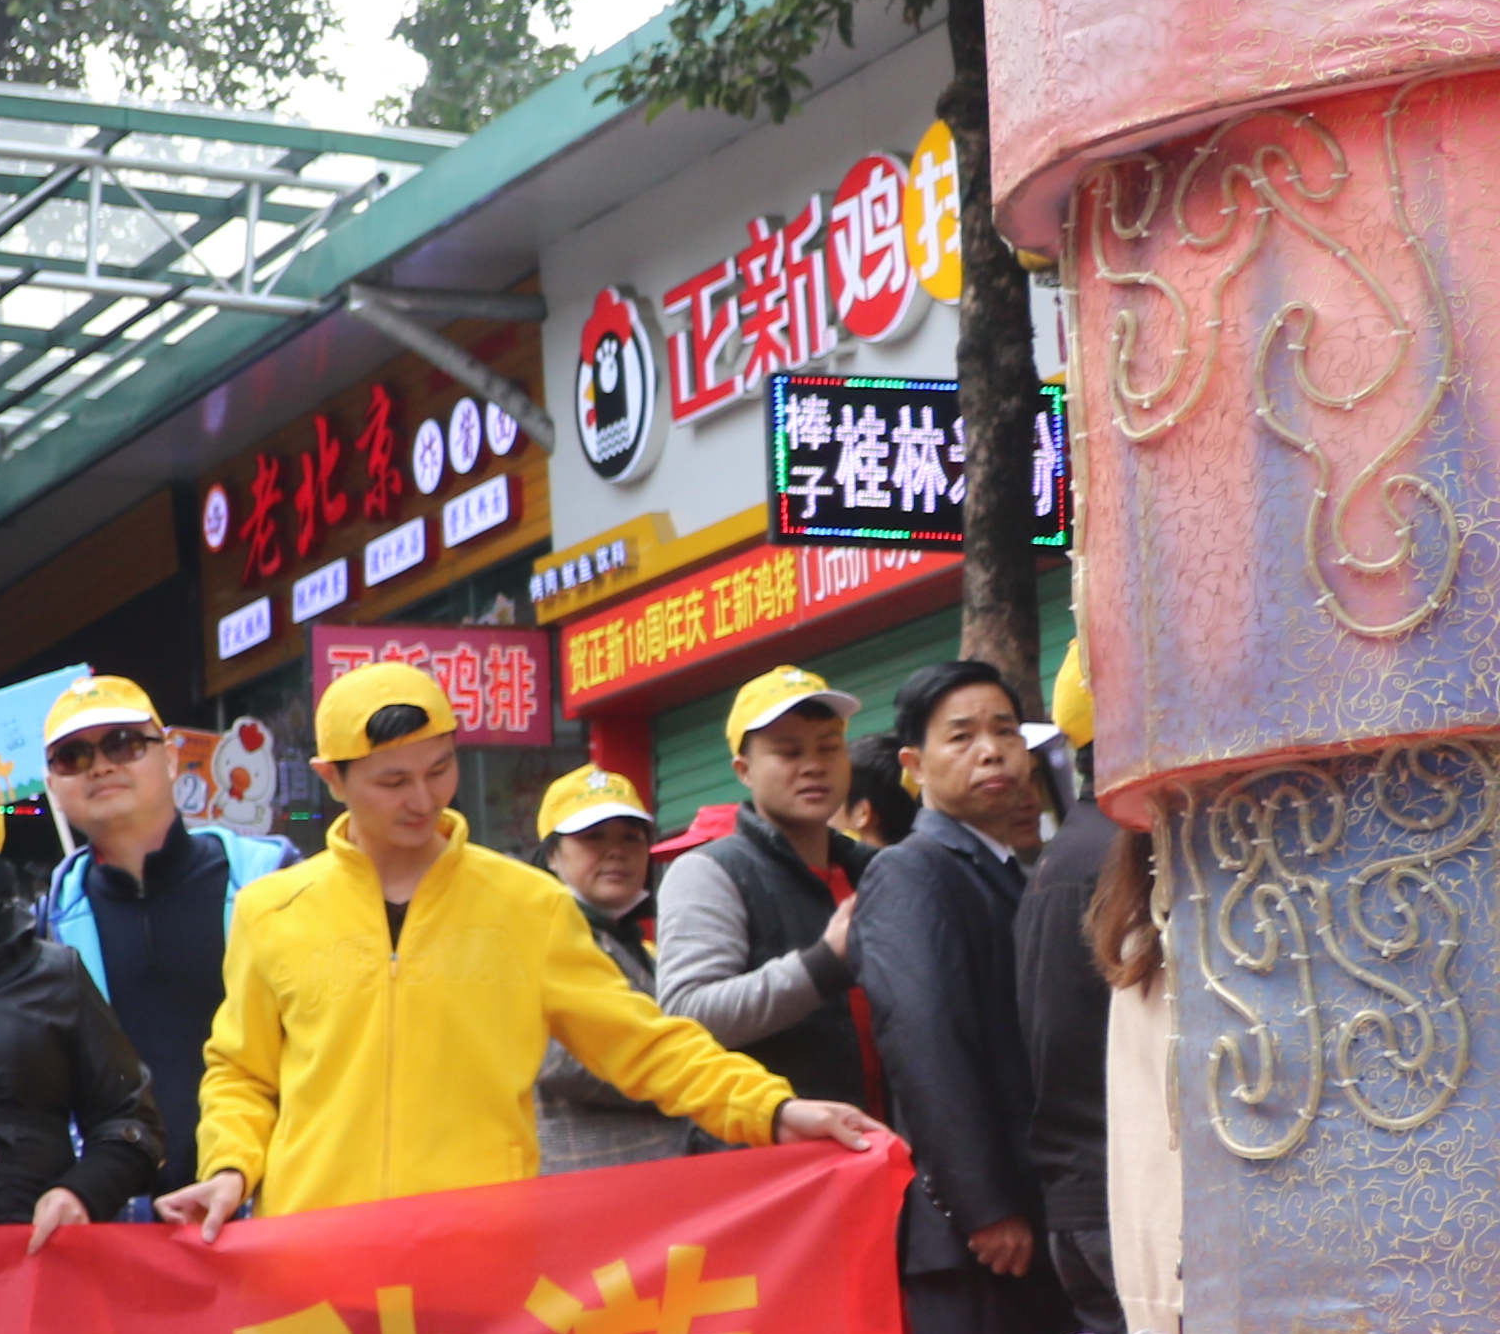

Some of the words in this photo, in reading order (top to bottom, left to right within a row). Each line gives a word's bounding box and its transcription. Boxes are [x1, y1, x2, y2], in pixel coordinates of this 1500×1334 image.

[567, 588, 707, 695] 贺正新18周年庆
[712, 548, 800, 641] 正新鸡排
